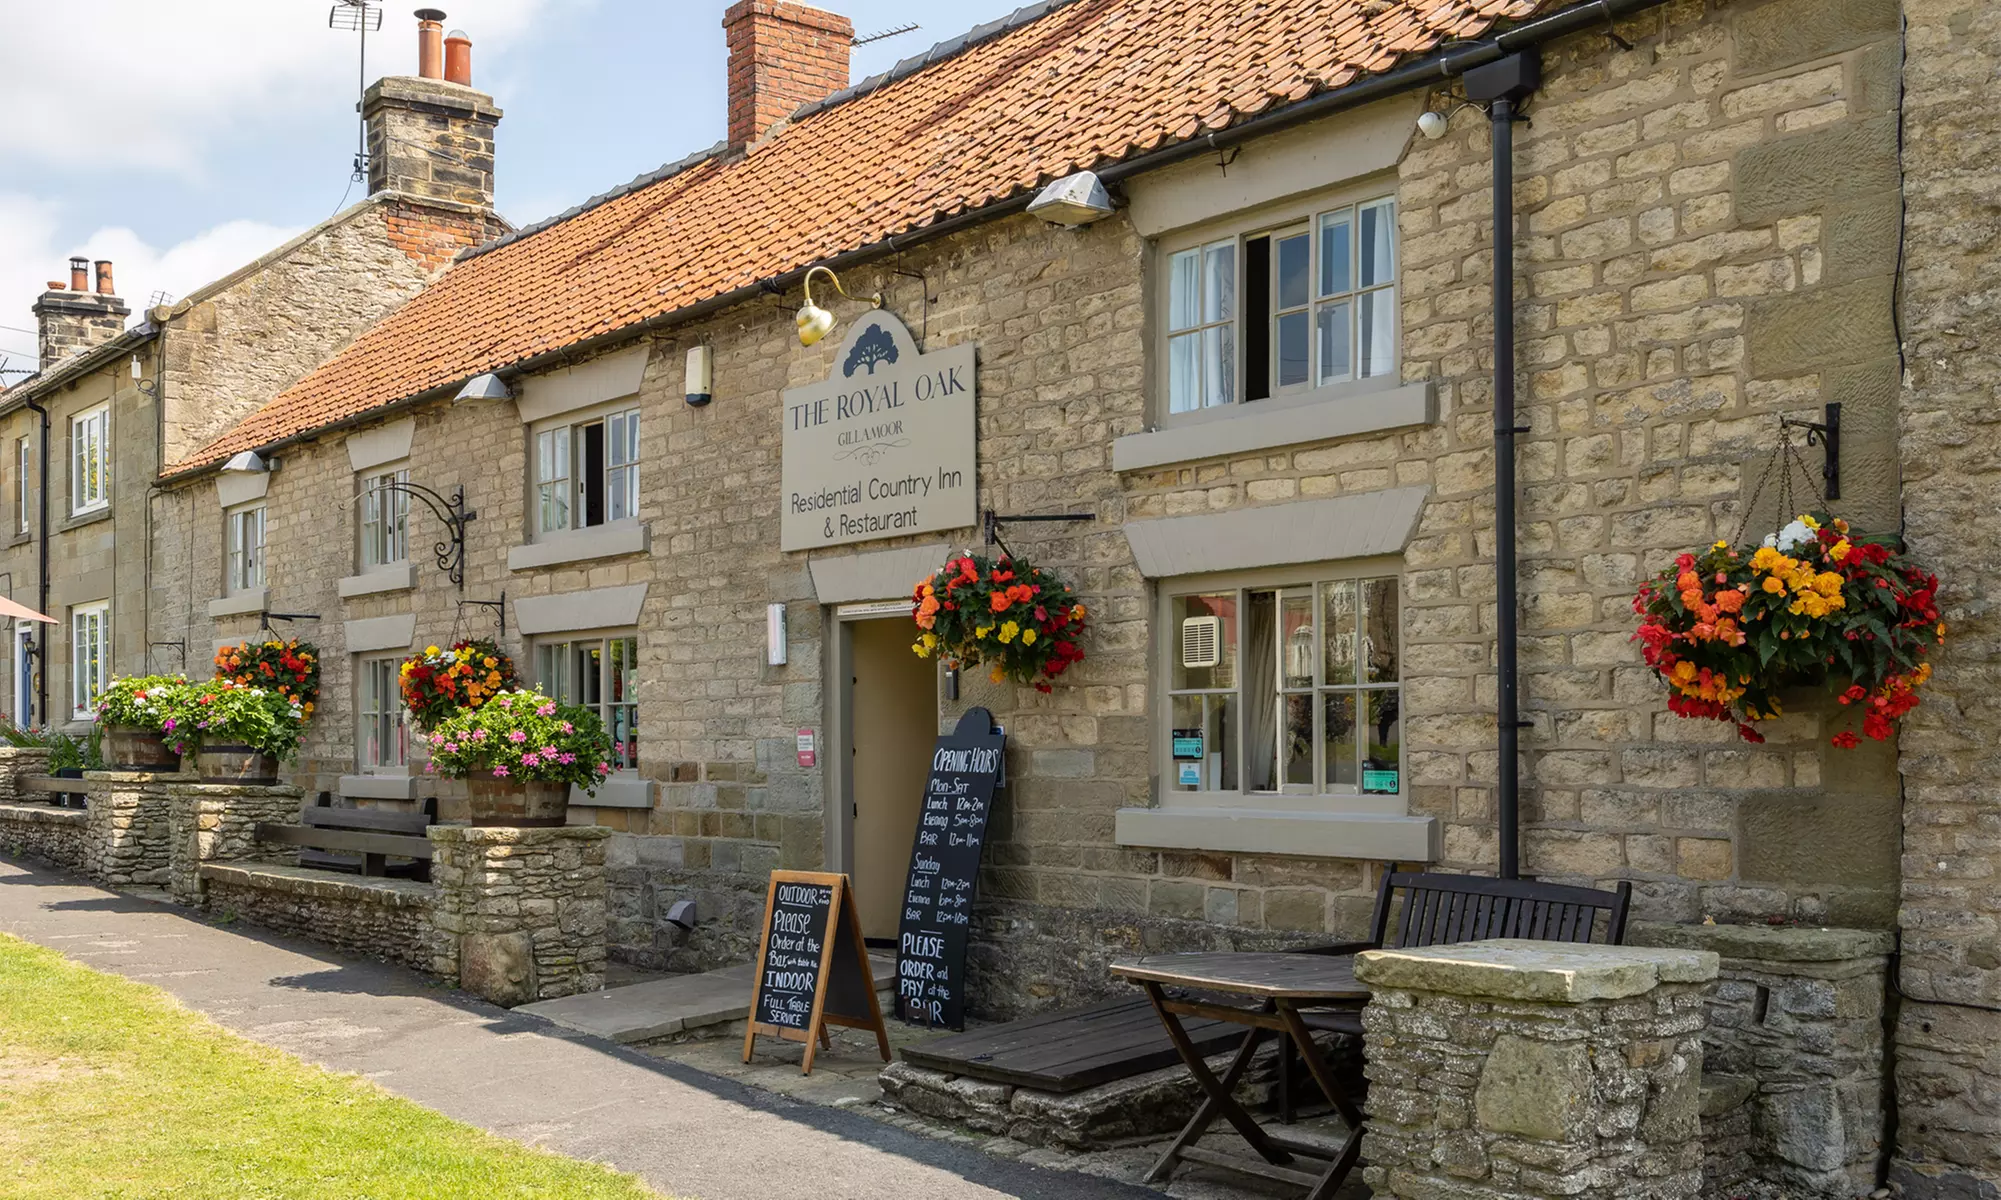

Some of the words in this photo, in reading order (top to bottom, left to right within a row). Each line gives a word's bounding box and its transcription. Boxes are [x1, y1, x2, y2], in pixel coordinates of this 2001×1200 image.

[790, 399, 829, 430] THE
[837, 381, 905, 420] ROYAL
[916, 365, 966, 401] OAK
[838, 420, 903, 446] GILLAMOOR
[792, 481, 862, 514] Residential
[868, 474, 932, 497] Country
[939, 467, 962, 490] Inn
[824, 517, 835, 538] &
[840, 506, 918, 536] Restaurant
[934, 748, 971, 772] OPENING
[969, 747, 999, 773] HOURS
[927, 796, 948, 810] Lunch
[920, 830, 939, 845] BAR
[913, 852, 940, 875] Sunday
[911, 873, 930, 888] Lunch
[779, 885, 818, 905] OUTDOOR
[906, 907, 922, 921] BAR
[771, 933, 796, 950] Order
[795, 936, 805, 951] at
[807, 938, 820, 953] the
[902, 932, 945, 959] PLEASE
[900, 959, 935, 981] ORDER
[936, 966, 949, 980] and
[765, 971, 814, 992] INDOOR
[901, 978, 925, 997] PAY
[927, 983, 937, 995] at
[938, 981, 950, 1000] the
[764, 994, 785, 1010] FULL
[787, 995, 810, 1013] TABLE
[768, 1009, 802, 1026] SERVICE
